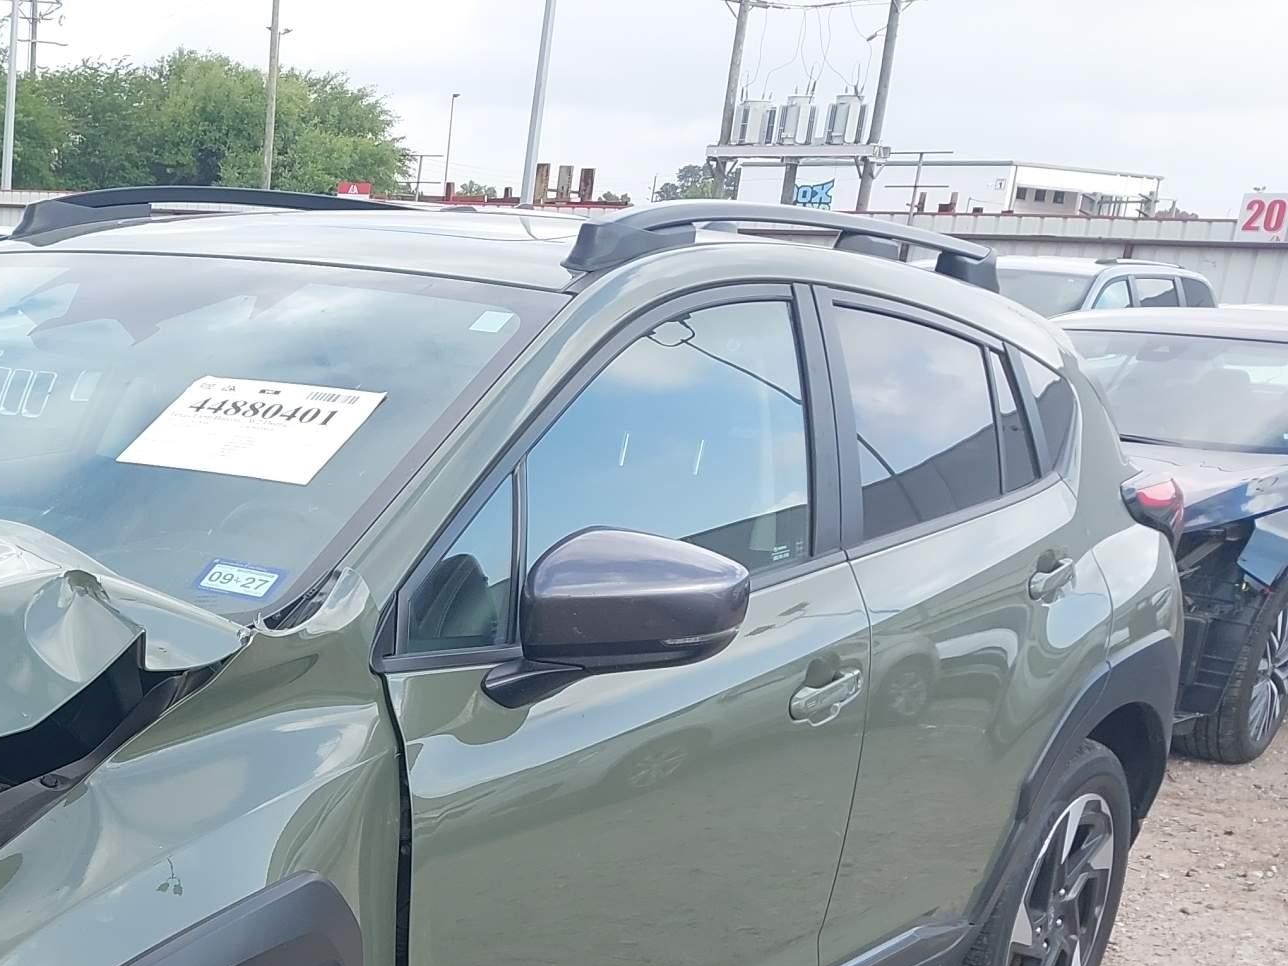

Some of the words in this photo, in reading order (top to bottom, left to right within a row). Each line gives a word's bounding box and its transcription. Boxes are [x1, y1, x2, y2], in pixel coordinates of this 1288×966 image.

[792, 178, 835, 204] OX
[1241, 199, 1287, 232] 20
[188, 397, 340, 426] 44880401
[208, 571, 235, 585] 09
[239, 576, 270, 591] 27
